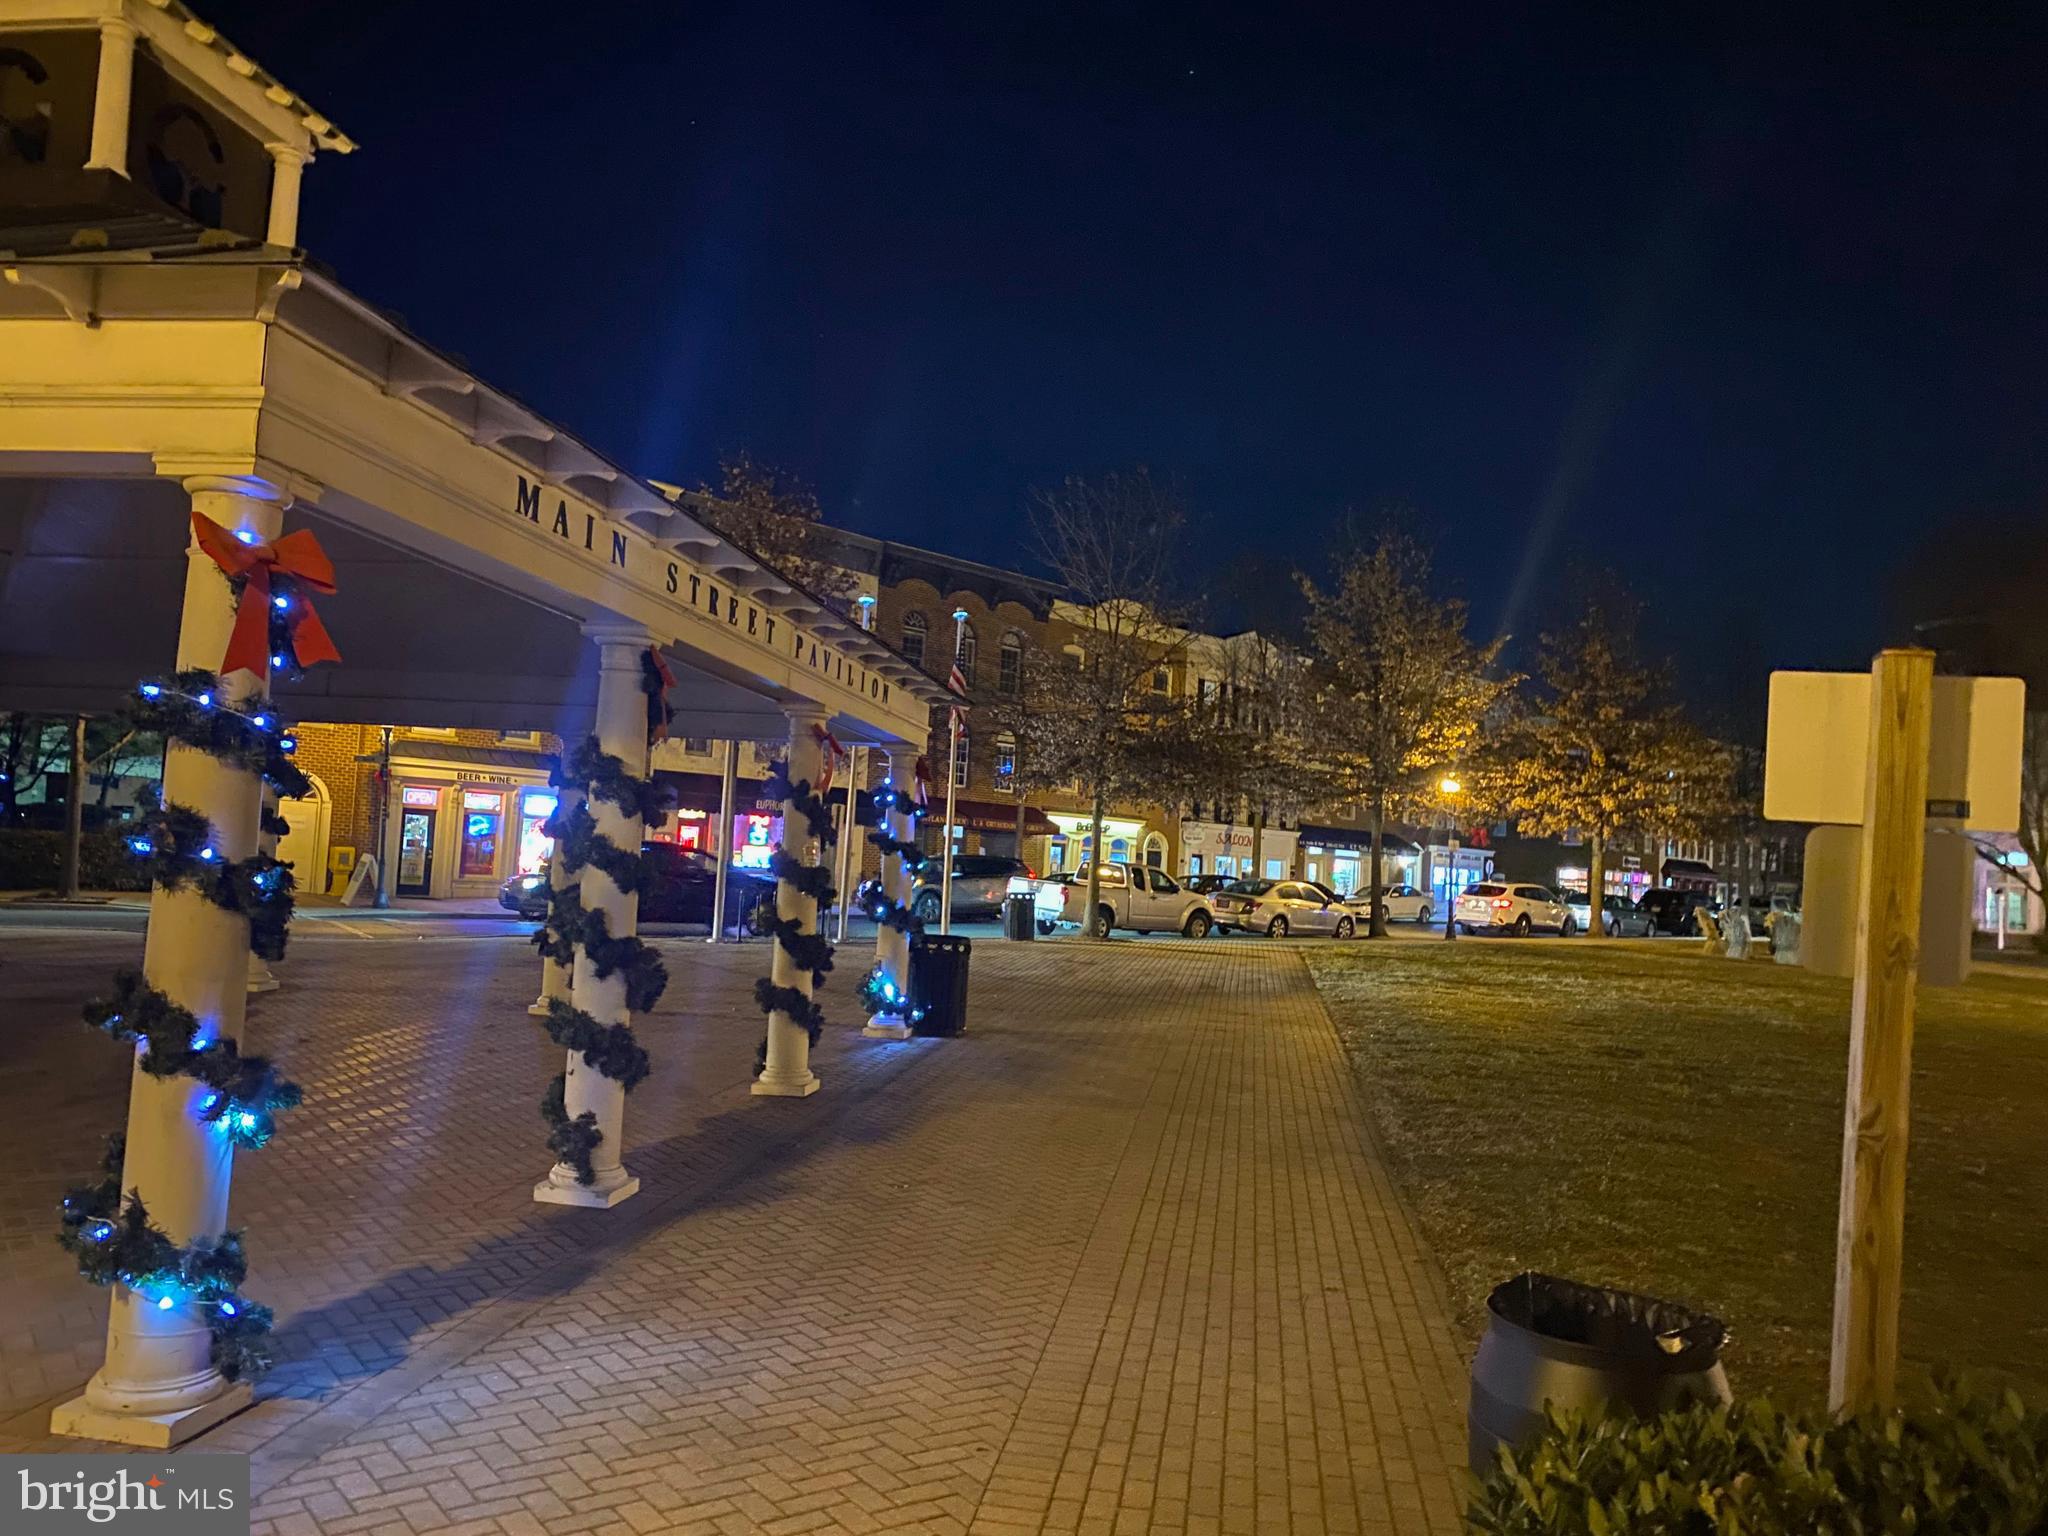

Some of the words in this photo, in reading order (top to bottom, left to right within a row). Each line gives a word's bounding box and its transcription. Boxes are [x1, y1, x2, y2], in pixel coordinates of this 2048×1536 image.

[514, 475, 628, 568] MAIN
[666, 564, 776, 645] STREET
[795, 633, 891, 705] PAVILION
[456, 771, 481, 782] BEER
[488, 775, 512, 785] WINE
[756, 799, 784, 811] EUPHOR
[1215, 832, 1253, 847] SALON
